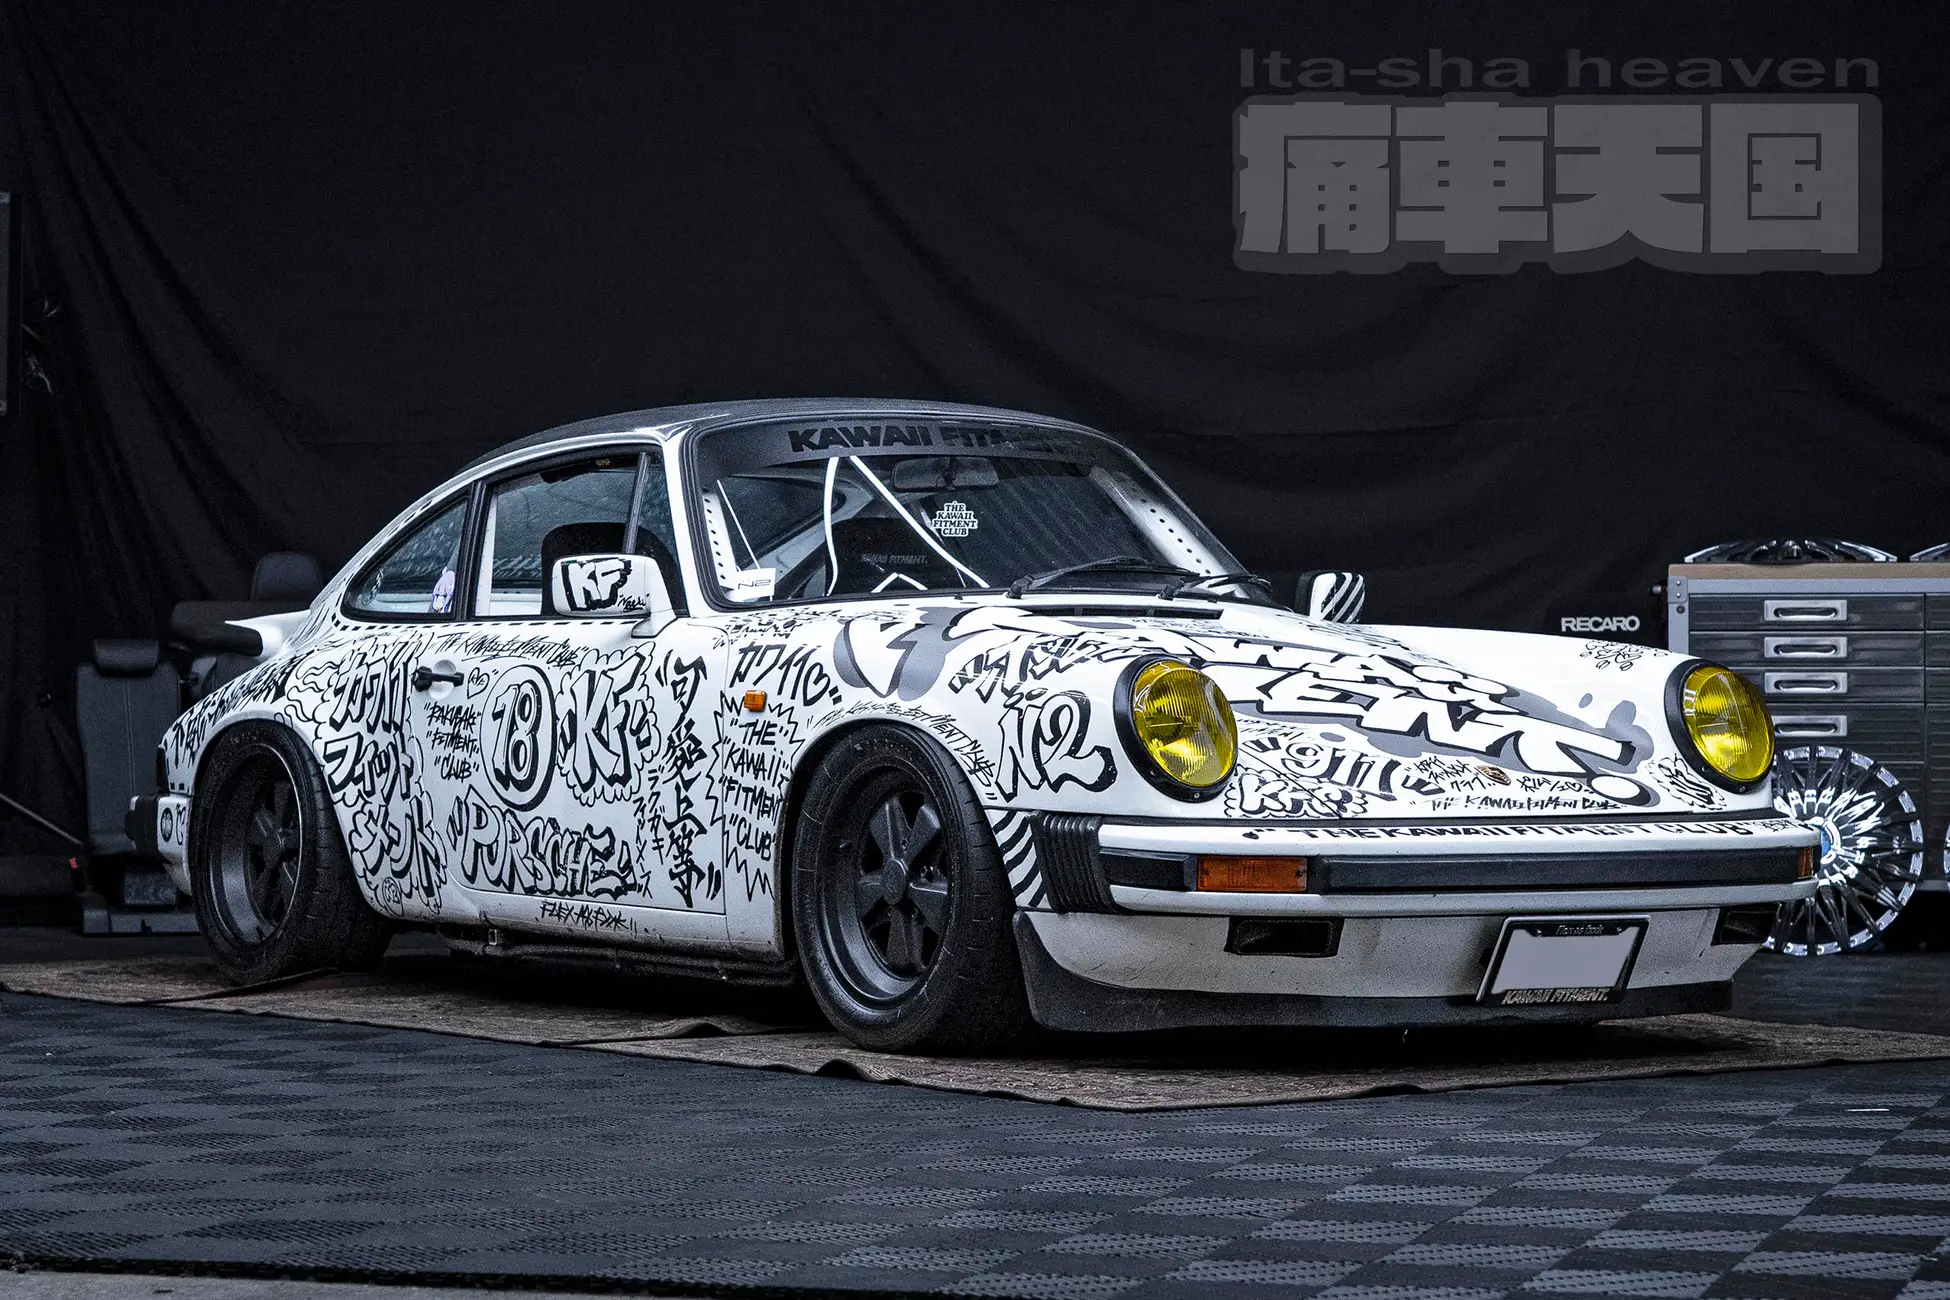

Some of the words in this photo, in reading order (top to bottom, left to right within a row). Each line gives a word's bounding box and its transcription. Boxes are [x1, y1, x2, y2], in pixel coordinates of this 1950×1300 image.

[788, 426, 932, 451] KAWAII
[945, 504, 965, 512] THE
[937, 511, 973, 520] KAWAII
[933, 520, 977, 528] FITMENT
[942, 528, 967, 536] CLUB
[1561, 615, 1640, 632] RECARO
